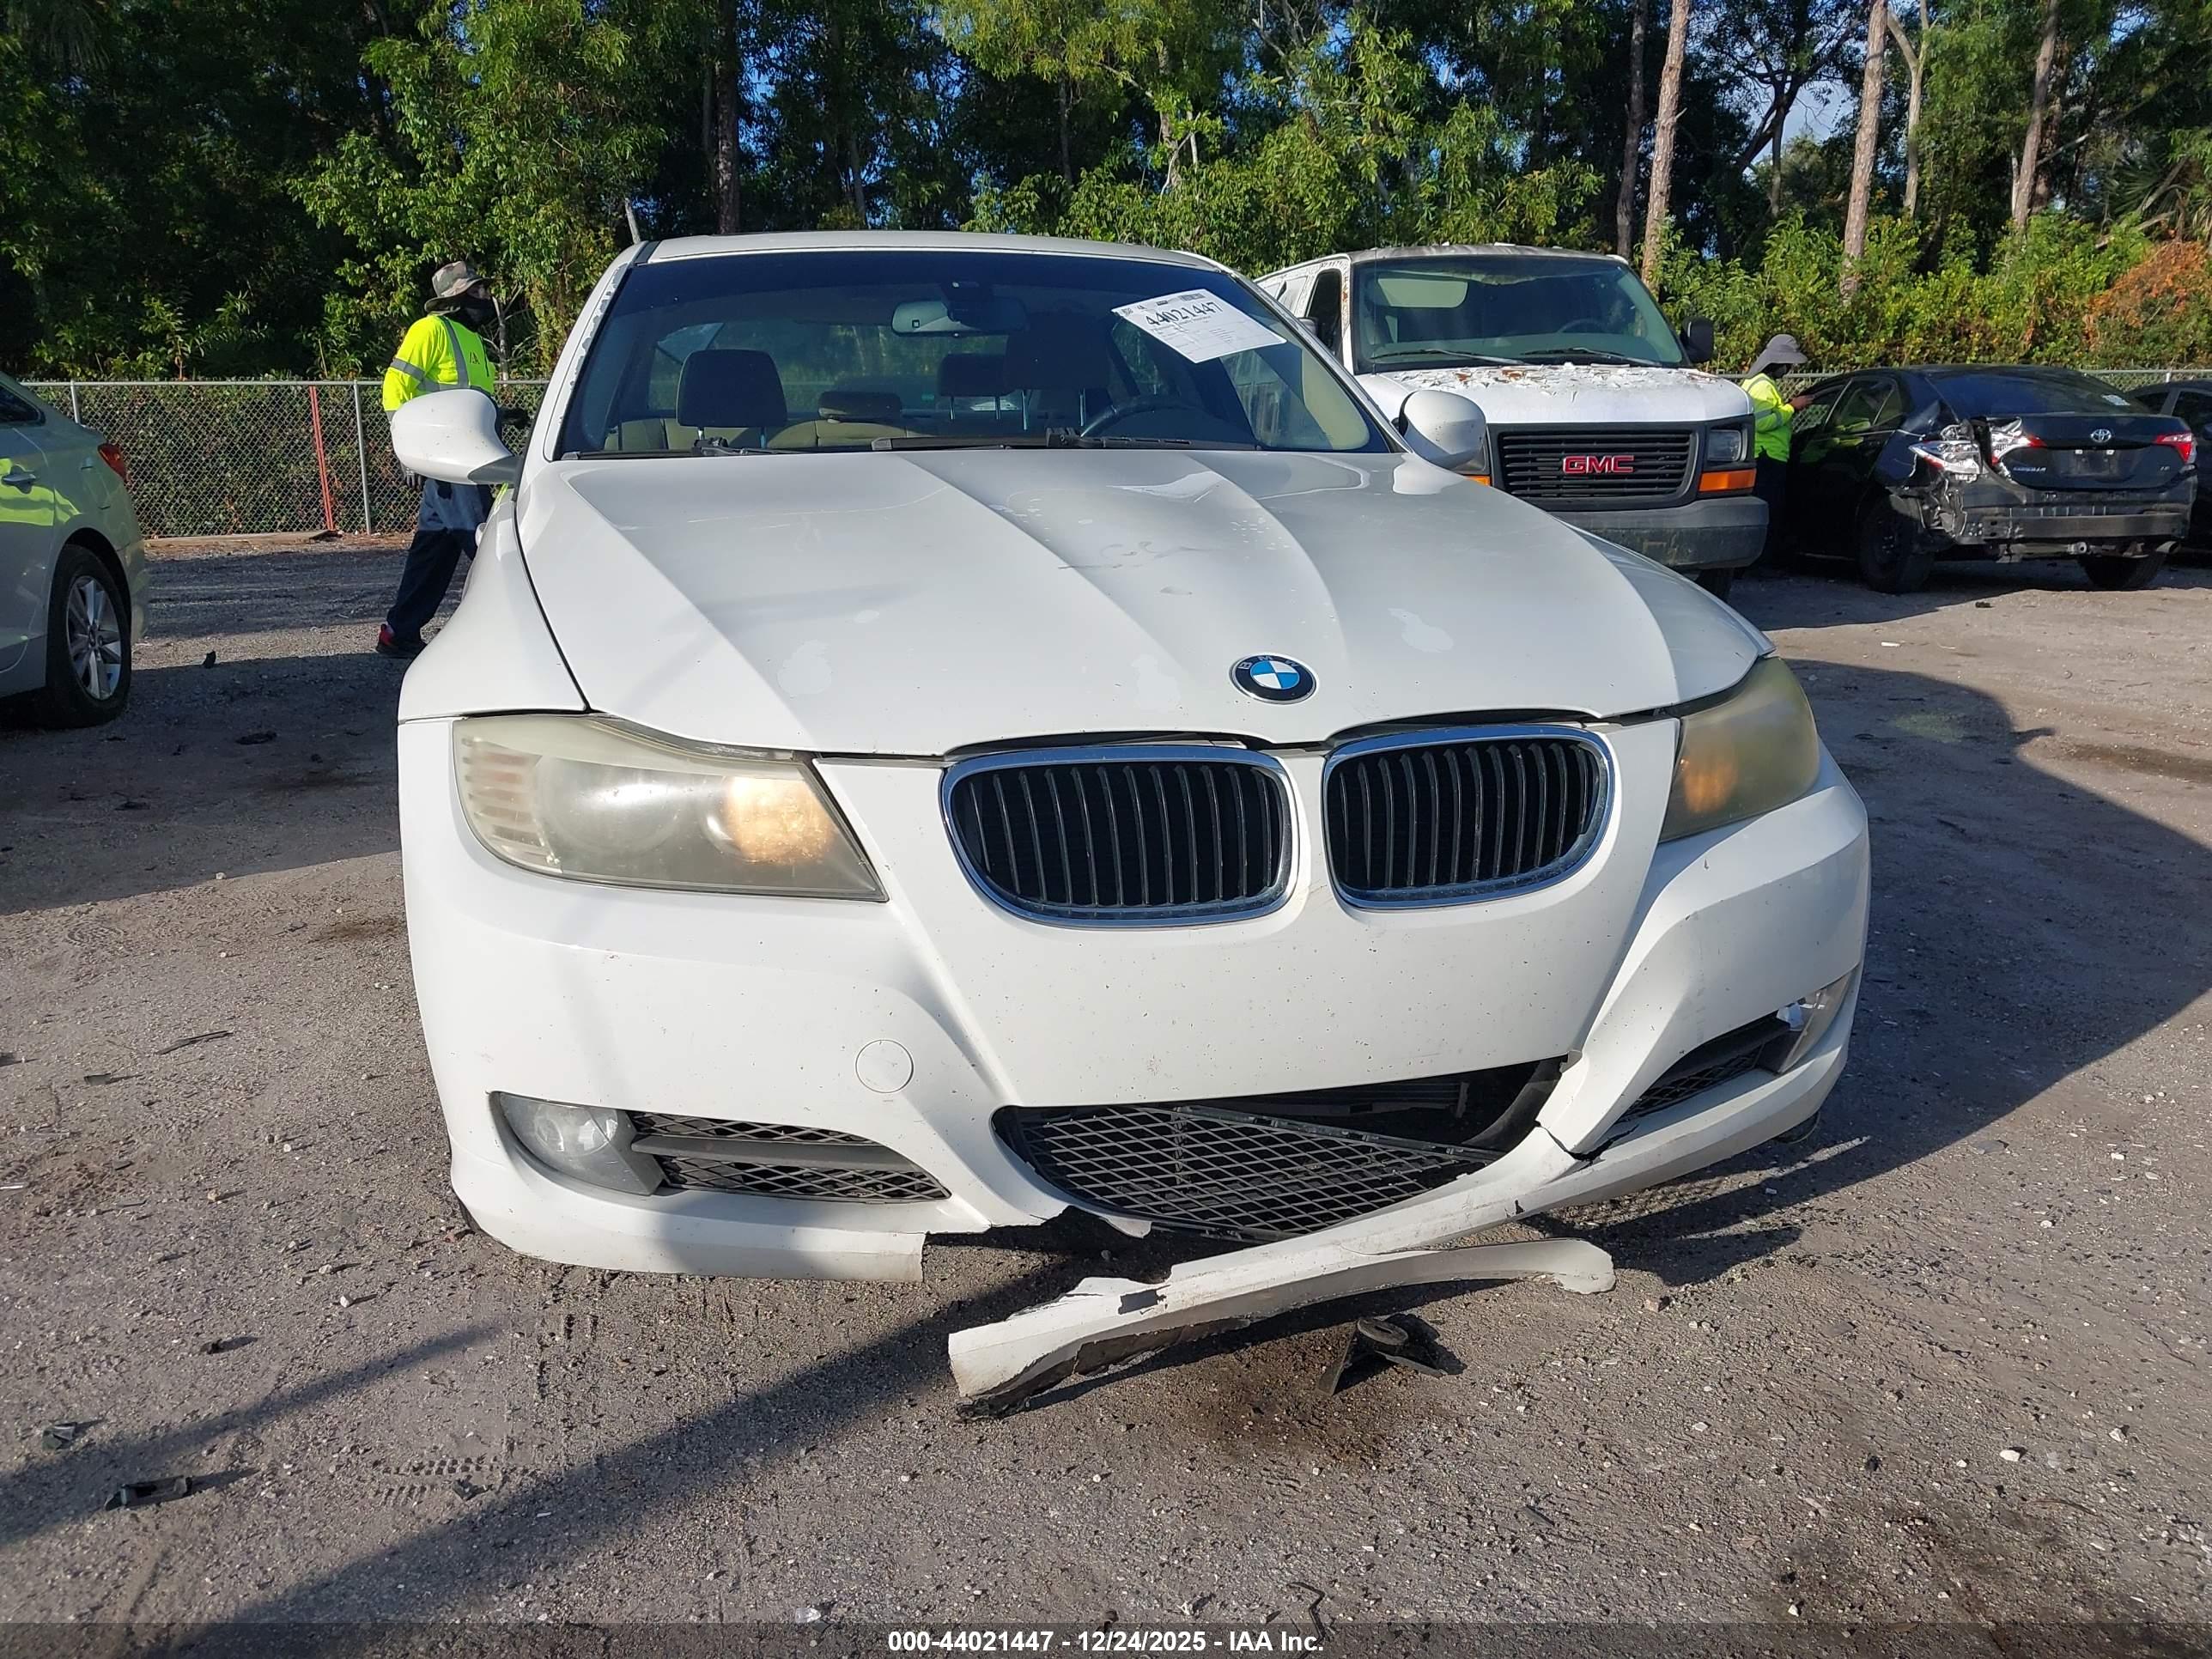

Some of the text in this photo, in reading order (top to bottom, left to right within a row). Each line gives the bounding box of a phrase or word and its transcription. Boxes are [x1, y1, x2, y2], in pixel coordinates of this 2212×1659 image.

[1146, 301, 1223, 325] 44021447
[1562, 455, 1635, 473] GMC
[1237, 655, 1299, 670] BMW
